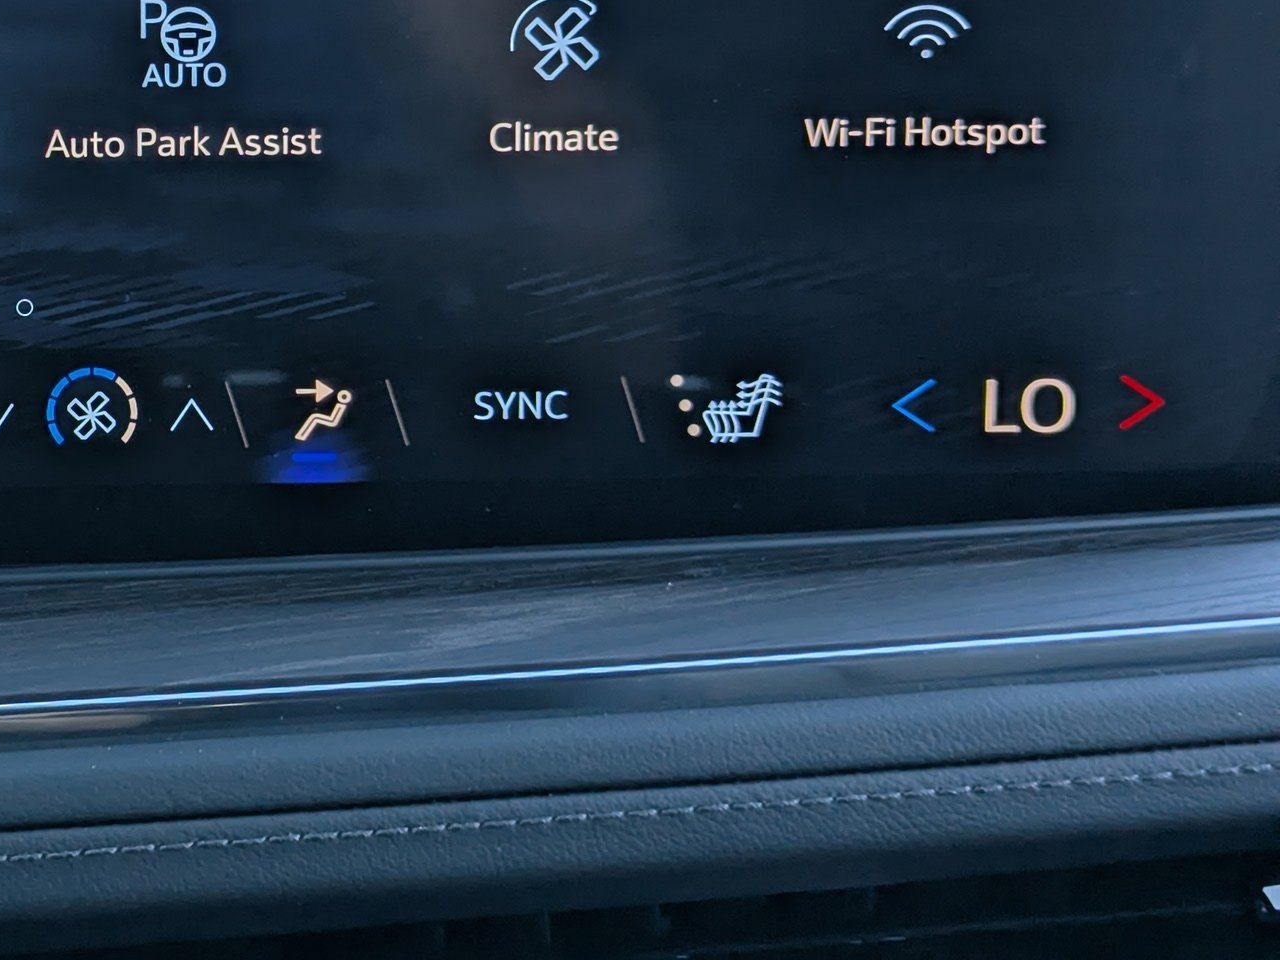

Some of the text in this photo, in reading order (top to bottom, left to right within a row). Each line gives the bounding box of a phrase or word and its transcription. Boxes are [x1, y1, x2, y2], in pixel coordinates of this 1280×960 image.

[141, 62, 227, 88] AUTO
[45, 125, 322, 159] Auto Park Assist
[489, 120, 619, 153] Climate
[804, 116, 1046, 154] Wi-Fi Hotspot
[473, 390, 568, 421] SYNC
[984, 377, 1076, 434] LO
